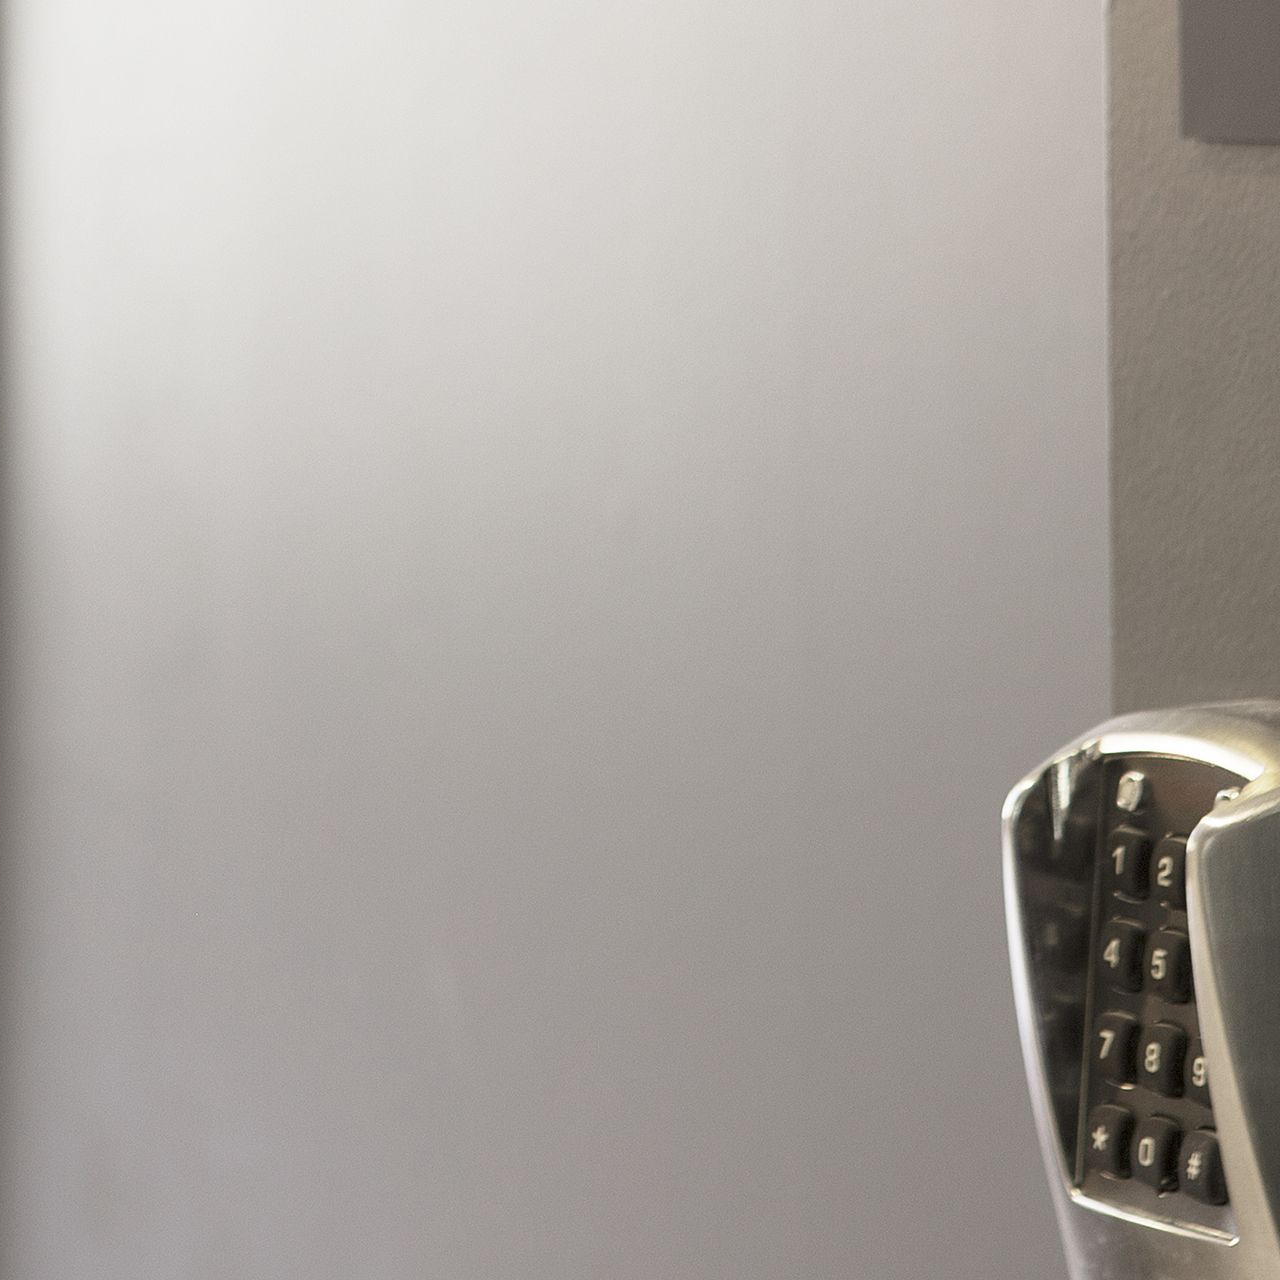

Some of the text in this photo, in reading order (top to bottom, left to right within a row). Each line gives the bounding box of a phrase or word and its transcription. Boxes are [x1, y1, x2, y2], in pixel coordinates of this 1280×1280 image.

[1111, 845, 1174, 888] 1 2
[1103, 939, 1168, 980] 4 5
[1099, 1030, 1207, 1087] 7 8 9
[1138, 1136, 1155, 1167] 0
